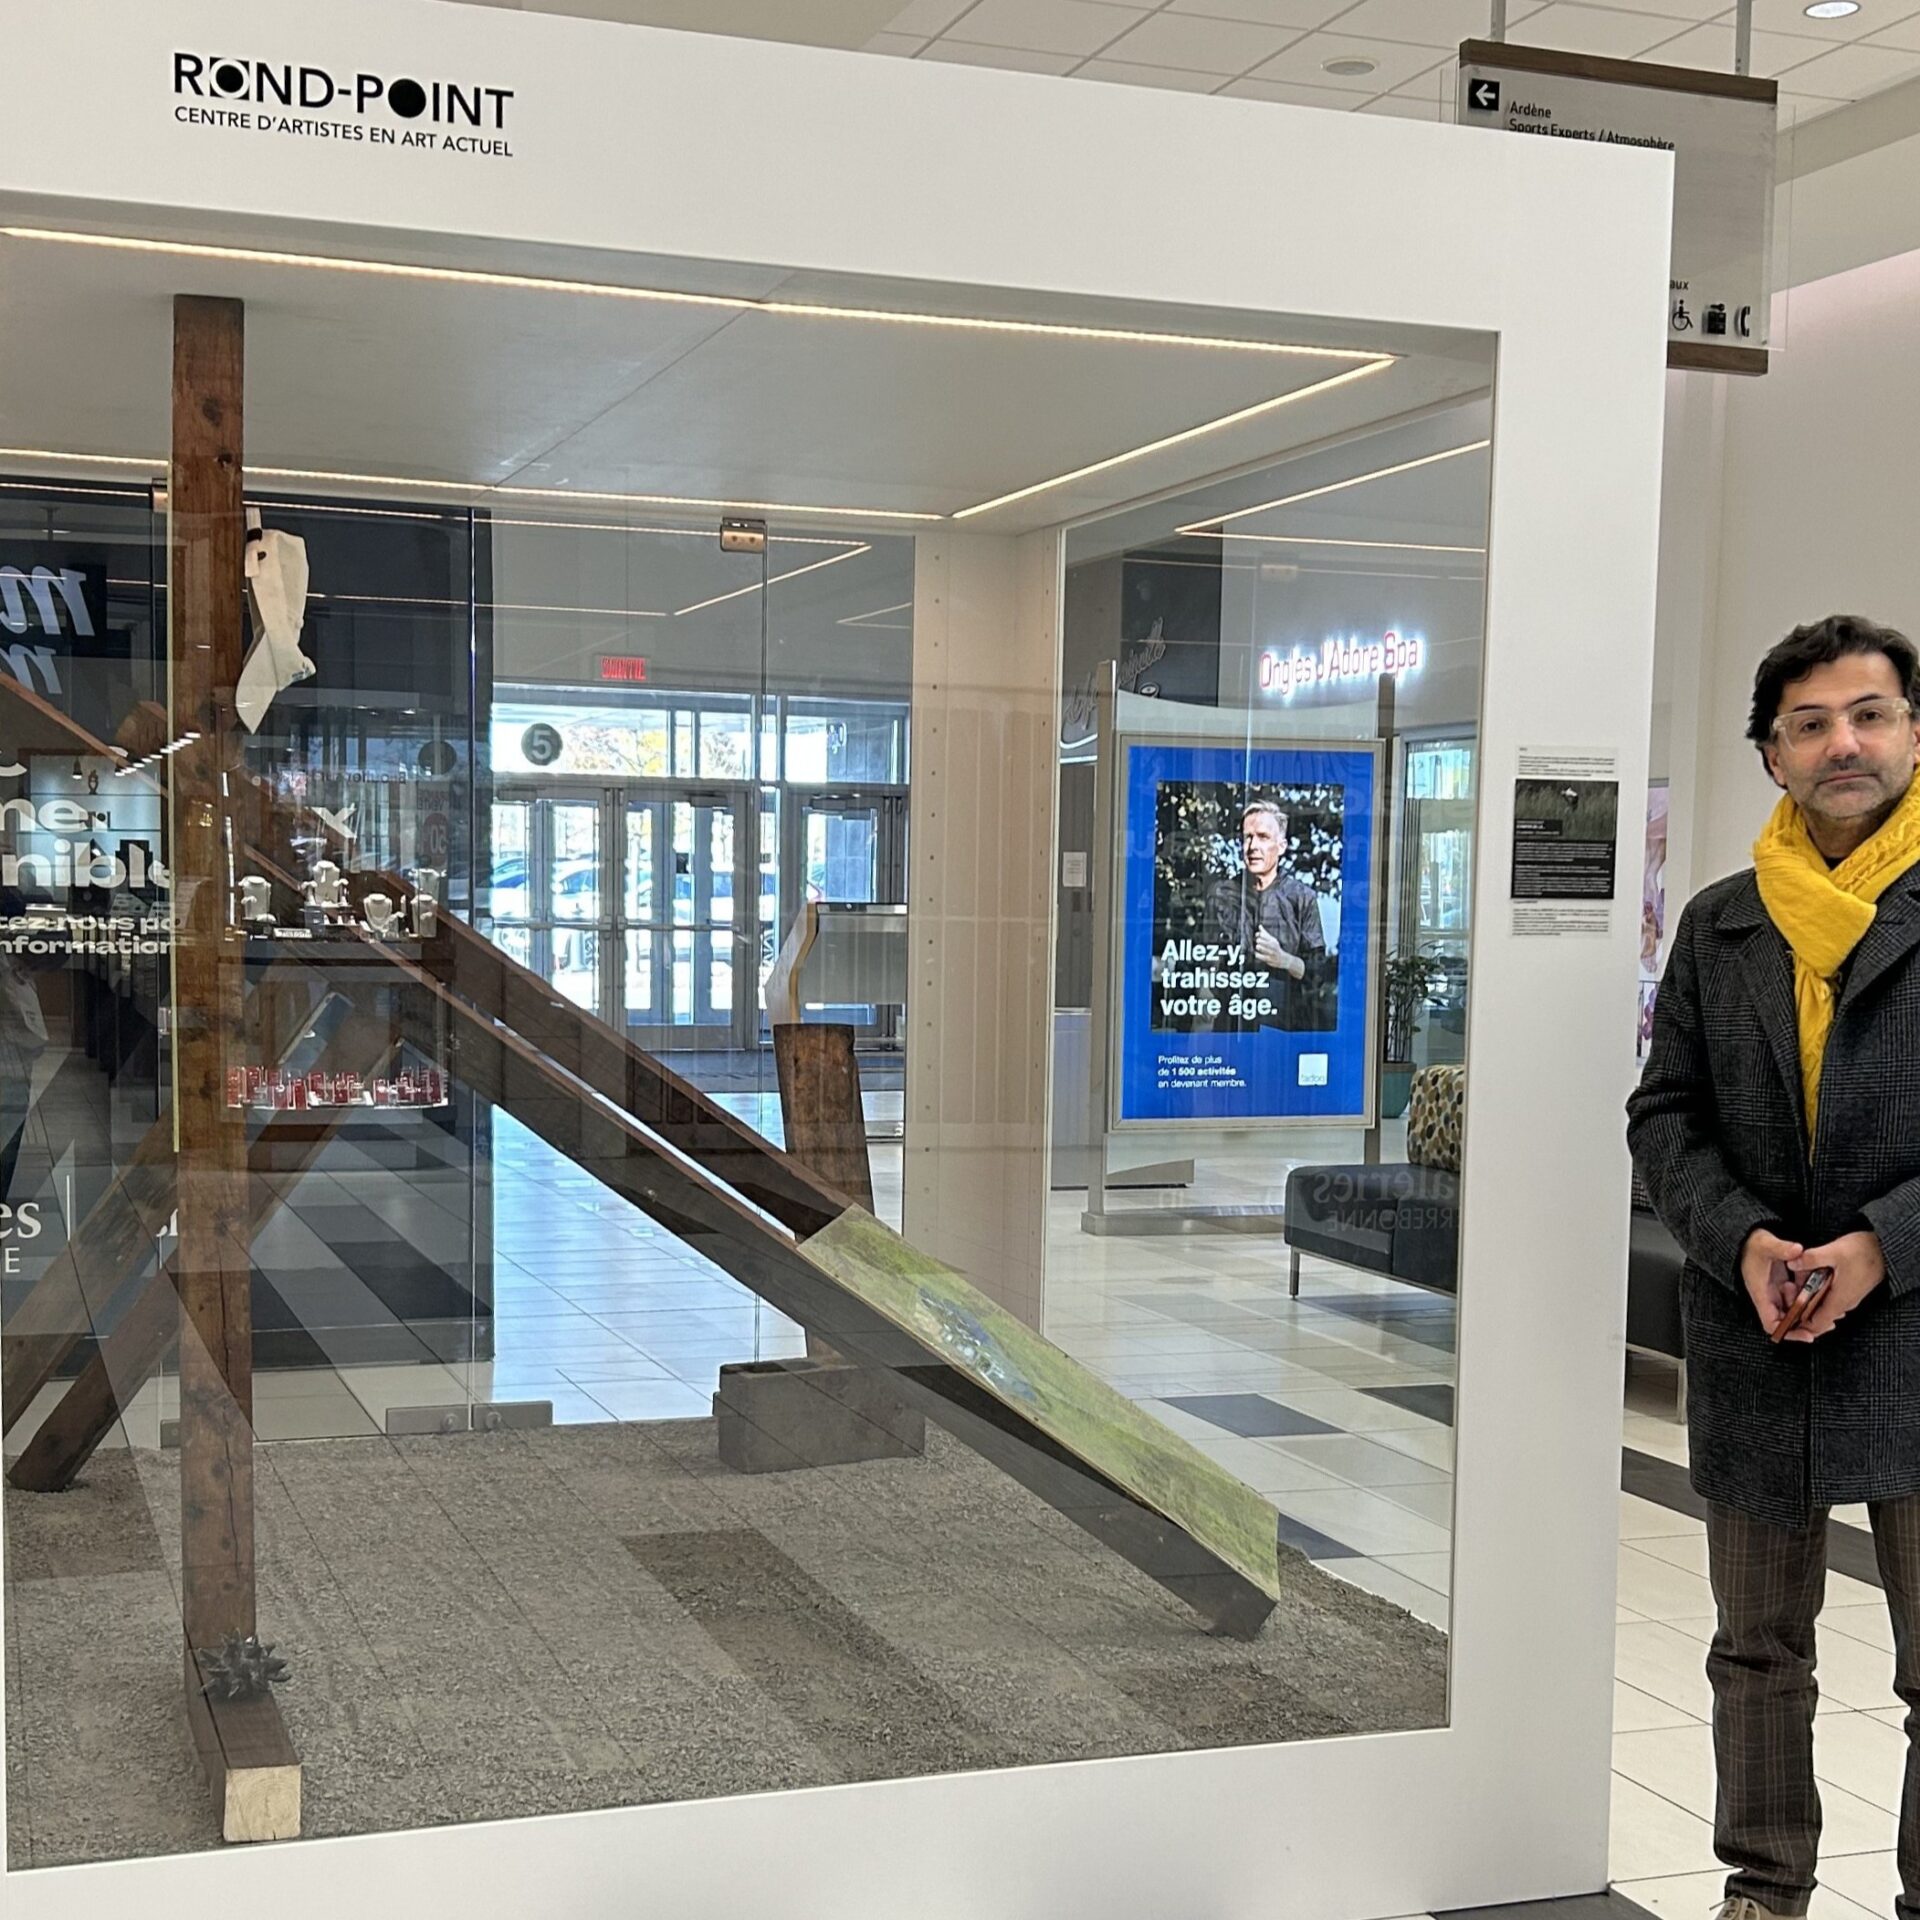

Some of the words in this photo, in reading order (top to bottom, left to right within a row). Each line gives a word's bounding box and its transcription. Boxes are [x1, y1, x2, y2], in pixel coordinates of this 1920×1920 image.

[174, 53, 514, 129] ROND-POINT
[1509, 101, 1552, 118] Ardène
[174, 106, 250, 128] CENTRE
[258, 116, 363, 141] D'ARTISTES
[370, 127, 395, 144] EN
[401, 131, 437, 149] ART
[442, 135, 514, 157] ACTUEL
[1508, 119, 1548, 135] Sports
[1551, 124, 1595, 141] Experts
[1259, 653, 1312, 694] Ongles
[1383, 631, 1418, 677] Spa
[531, 729, 552, 760] 5
[1161, 939, 1245, 966] Allez-y,
[1161, 967, 1270, 989] trahissez
[1160, 996, 1221, 1016] votre
[1228, 995, 1278, 1020] âge.
[1158, 1055, 1189, 1064] Profitez
[1191, 1055, 1202, 1064] de
[1204, 1055, 1222, 1066] plus
[1158, 1068, 1169, 1076] de
[1197, 1066, 1236, 1076] activités
[1171, 1079, 1208, 1088] devenant
[1210, 1079, 1247, 1088] membre.
